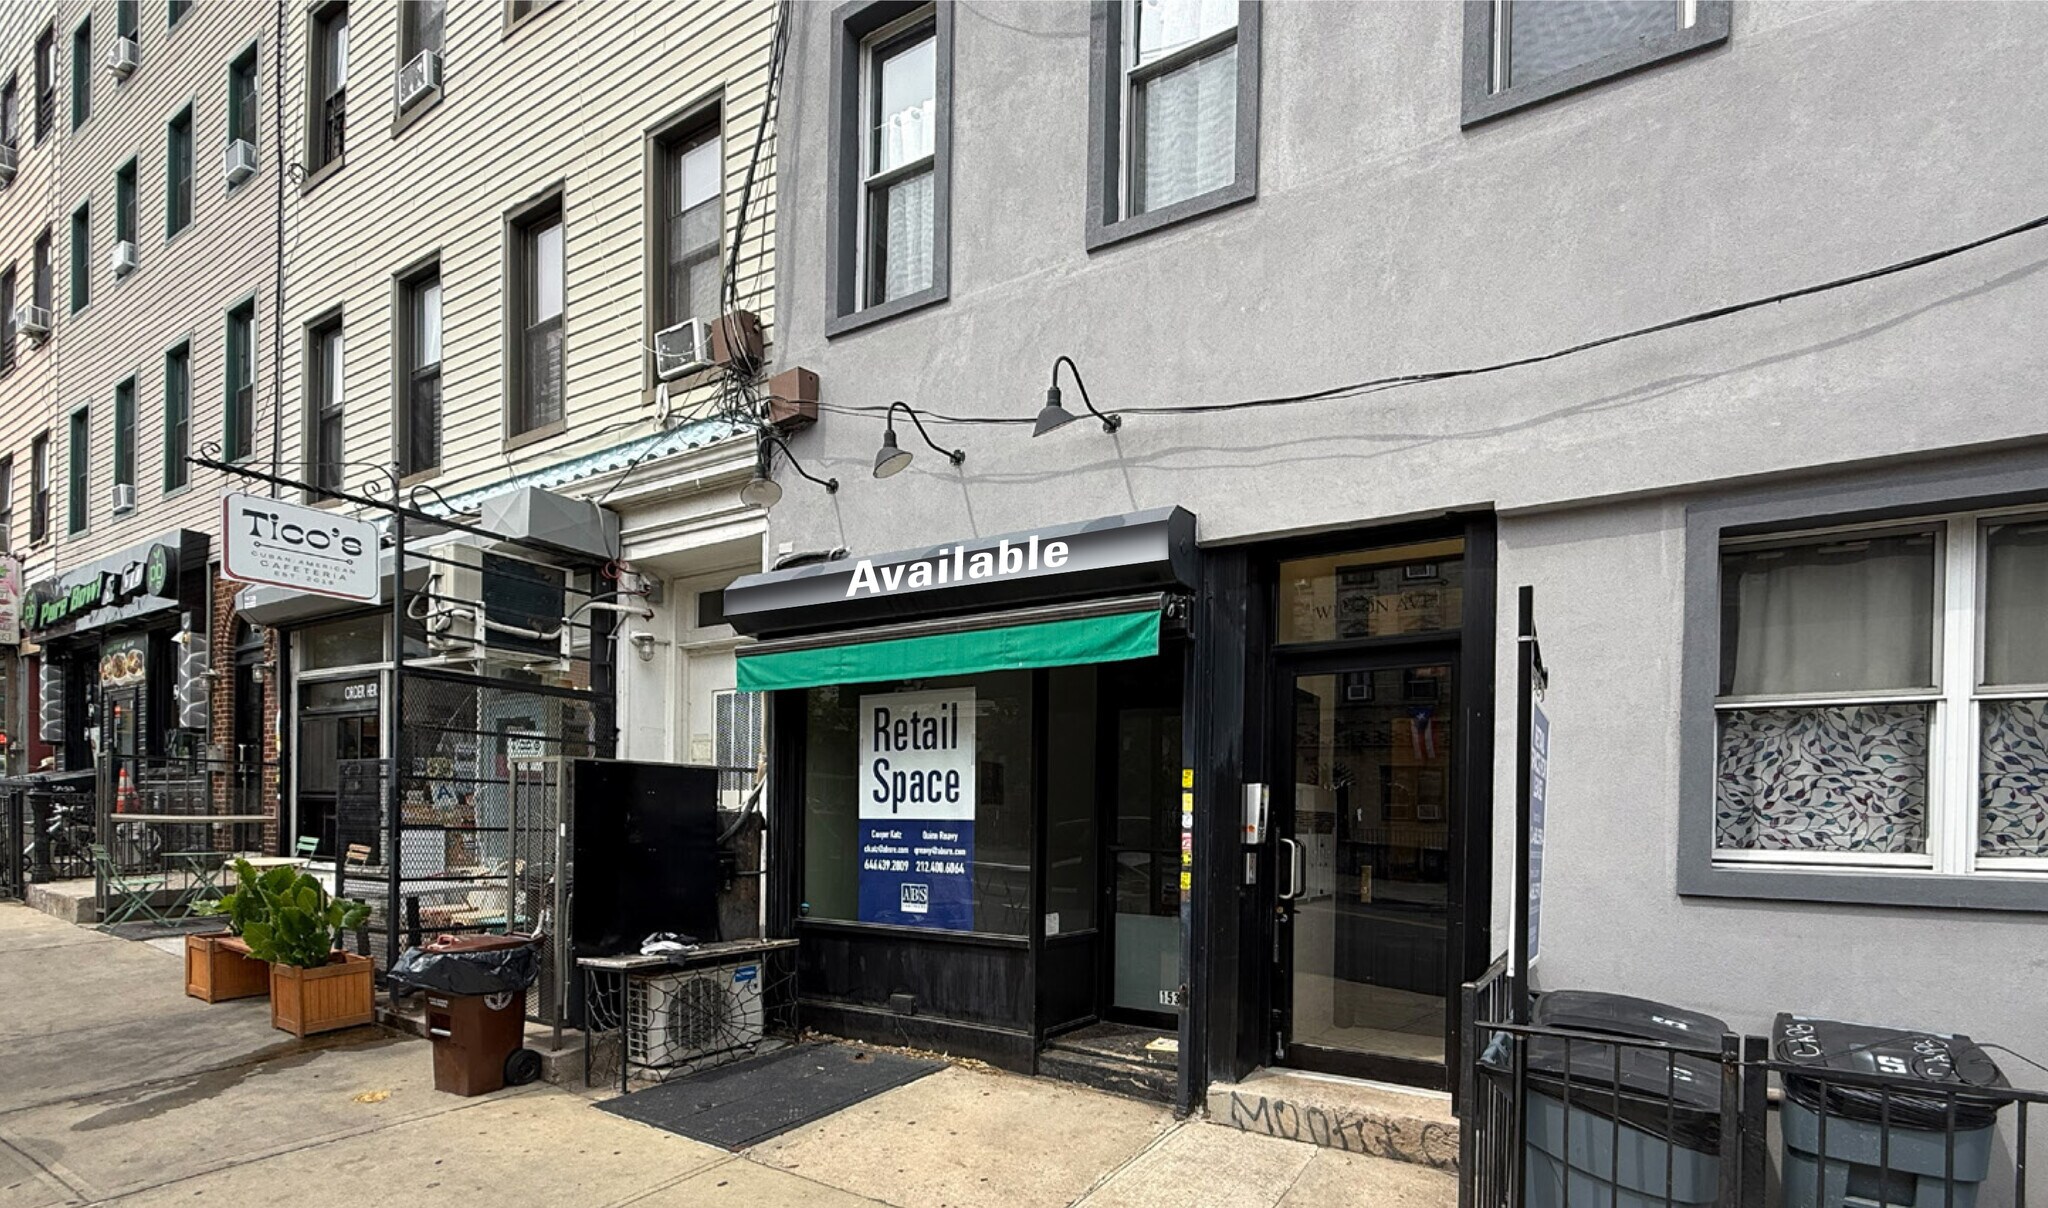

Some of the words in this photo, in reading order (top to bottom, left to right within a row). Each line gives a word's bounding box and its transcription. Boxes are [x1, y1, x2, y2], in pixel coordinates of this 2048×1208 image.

[242, 508, 363, 557] Tico's
[259, 559, 347, 581] CAFETERIA
[845, 534, 1070, 598] Available
[39, 596, 67, 627] Pure
[69, 571, 103, 613] Bowl
[873, 702, 957, 752] Retail
[872, 758, 960, 814] Space
[902, 885, 927, 902] ABS
